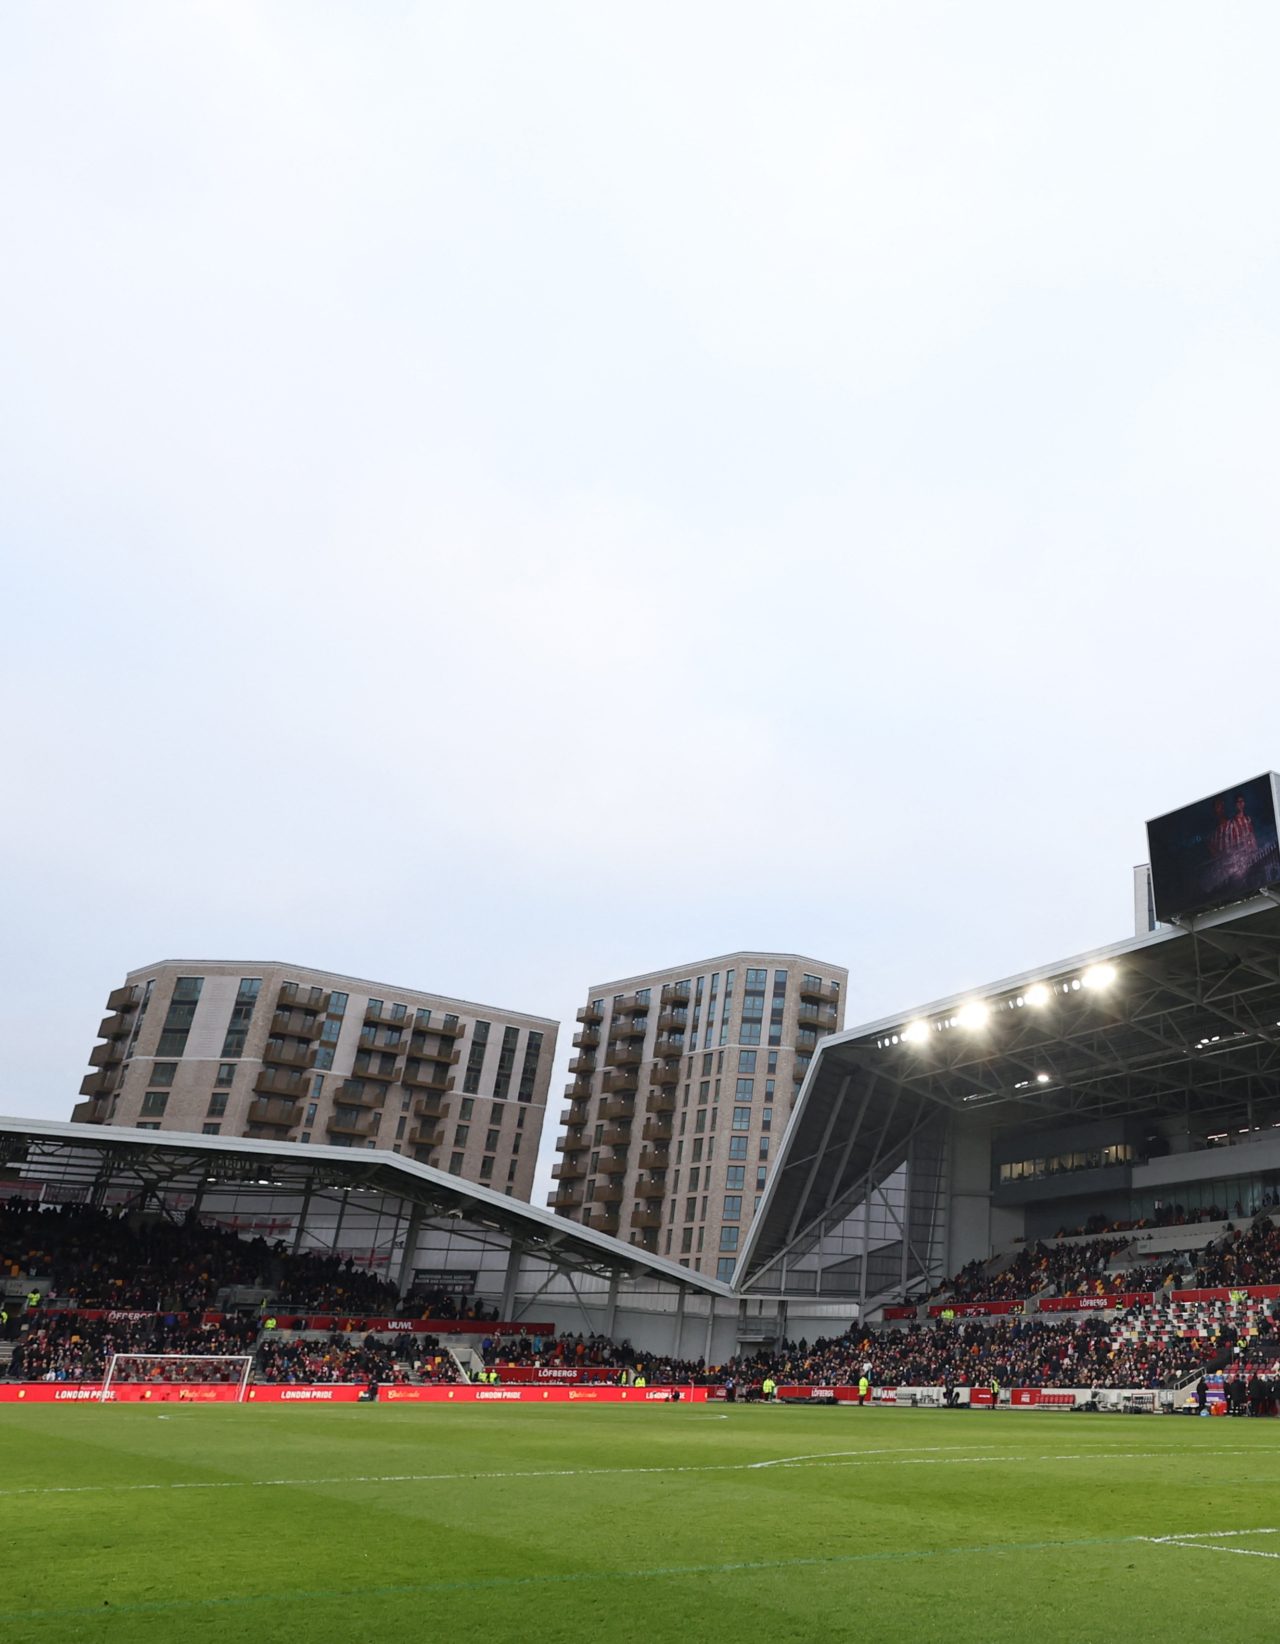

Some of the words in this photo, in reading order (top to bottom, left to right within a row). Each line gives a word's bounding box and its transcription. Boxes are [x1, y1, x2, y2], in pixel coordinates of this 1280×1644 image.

[1079, 1298, 1108, 1307] LÖFBERGS
[538, 1368, 578, 1377] LÖFBERGS
[55, 1390, 89, 1399] LONDON
[281, 1391, 311, 1399] LONDON
[311, 1391, 333, 1399] PRIDE
[476, 1391, 502, 1399] LONDON
[502, 1391, 522, 1399] PRIDE
